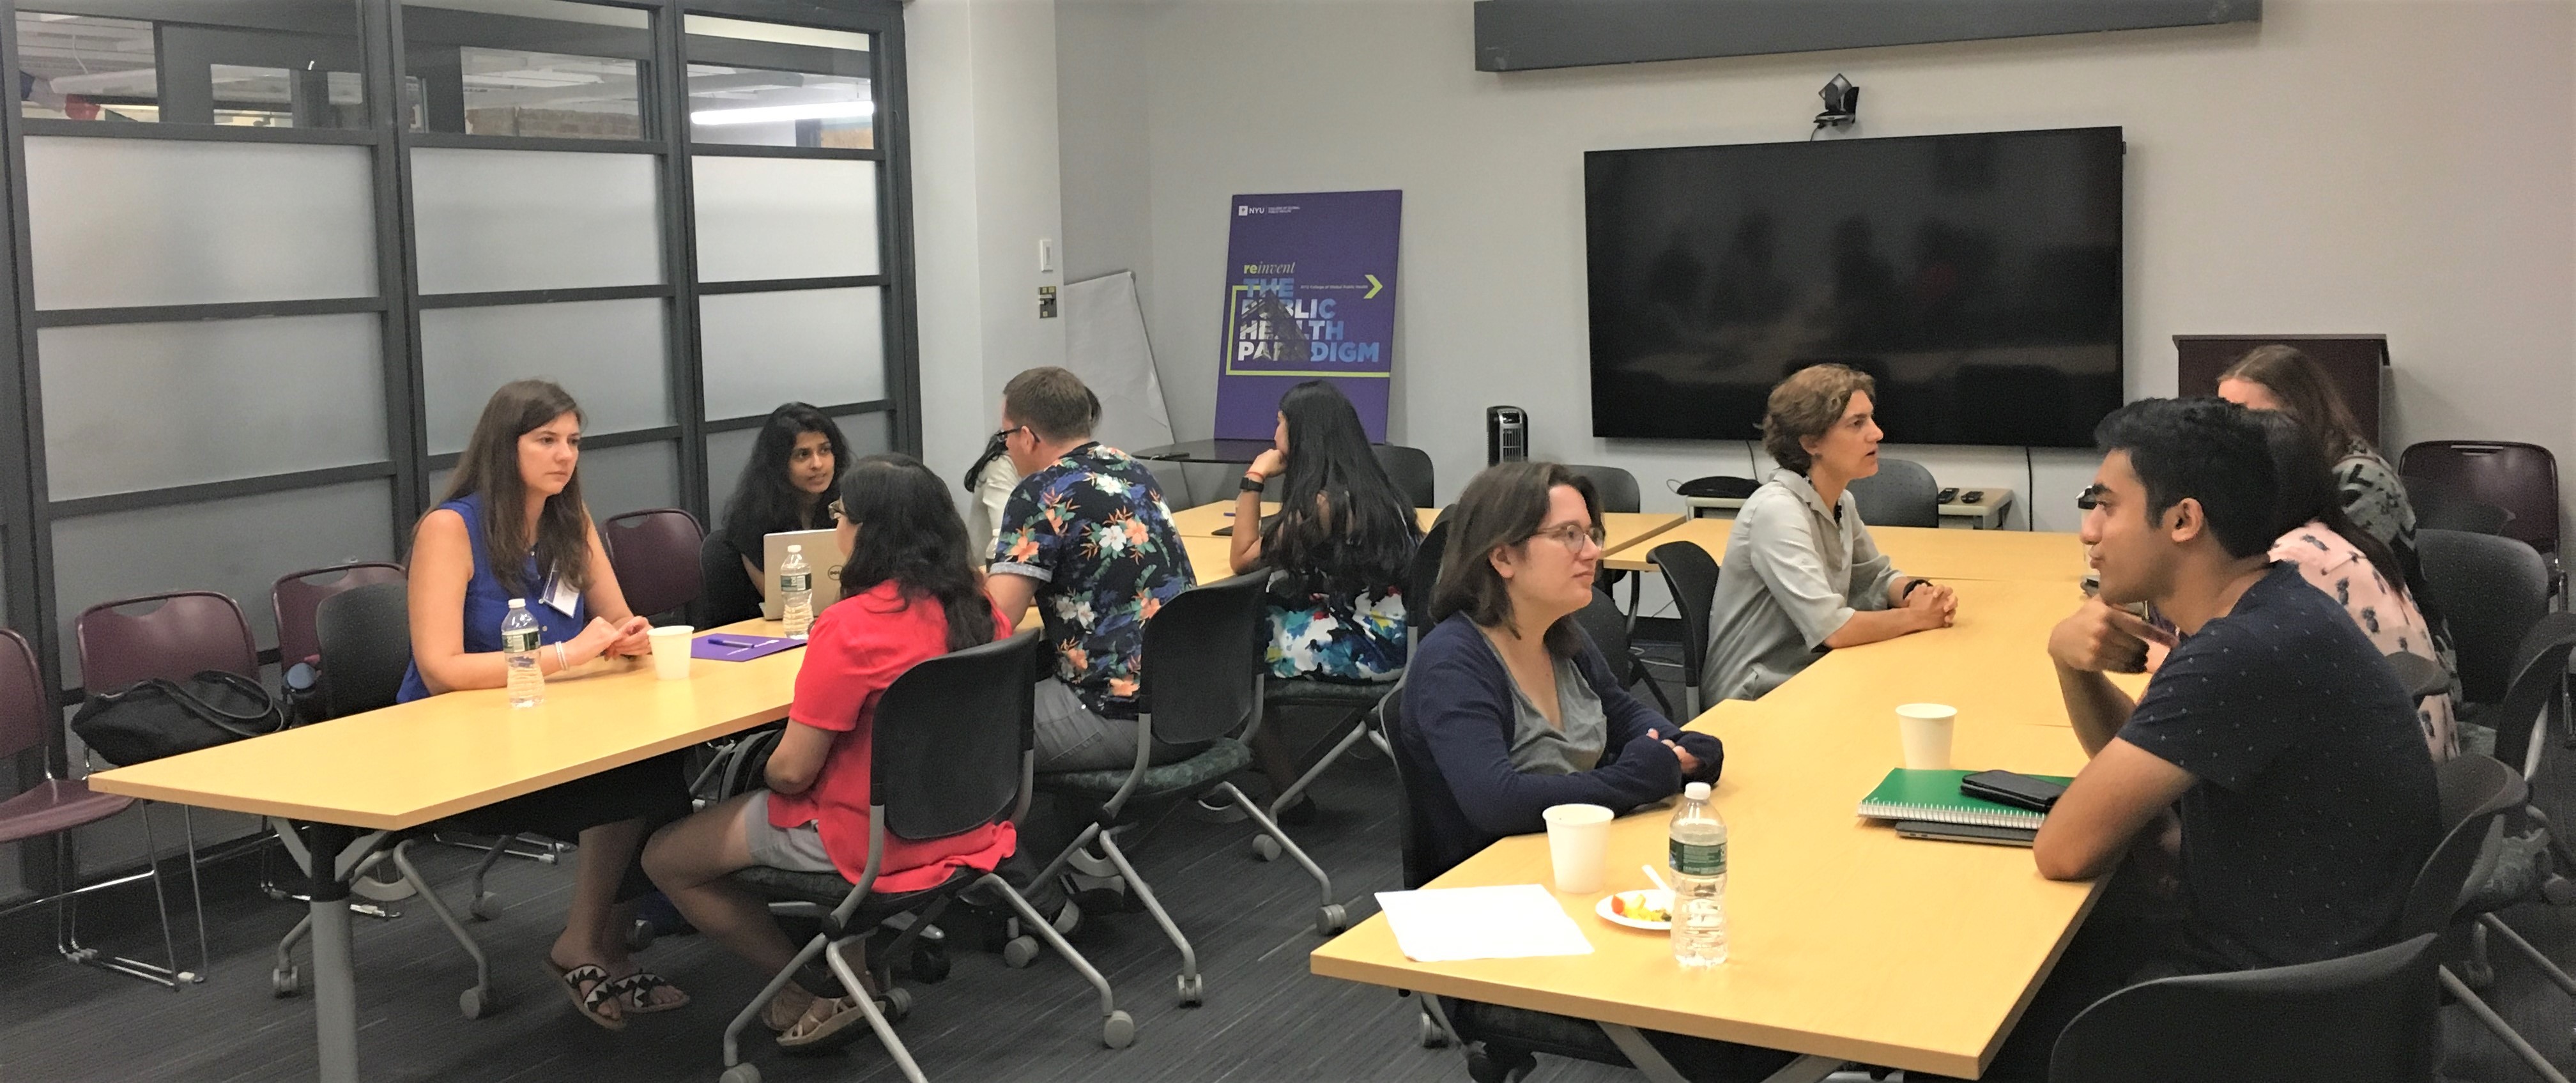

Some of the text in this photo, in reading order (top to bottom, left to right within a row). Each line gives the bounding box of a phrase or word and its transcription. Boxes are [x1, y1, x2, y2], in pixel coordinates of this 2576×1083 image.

[1243, 261, 1296, 274] reinvent
[1243, 277, 1294, 298] THE
[1241, 298, 1337, 319] PBLIC
[1239, 320, 1345, 340] HELTH
[1238, 341, 1380, 363] PADIGM
